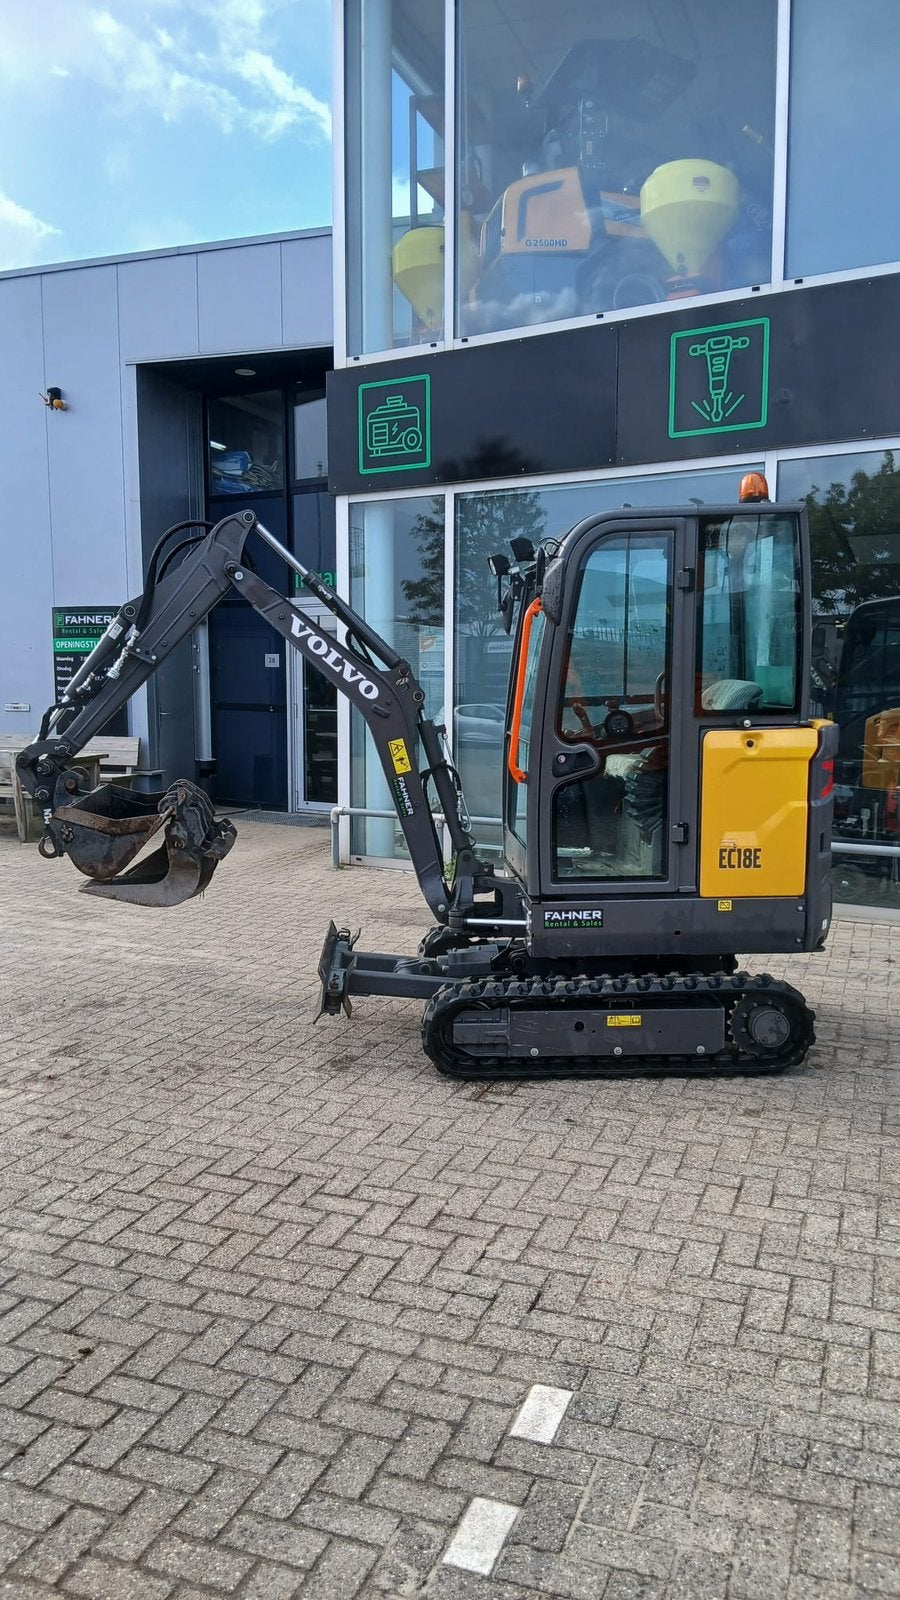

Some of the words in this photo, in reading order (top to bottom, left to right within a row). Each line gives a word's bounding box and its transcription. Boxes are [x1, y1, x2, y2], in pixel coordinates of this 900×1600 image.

[525, 239, 568, 247] G2500HD
[65, 616, 111, 624] FAHNER
[291, 613, 379, 700] VOLVO
[398, 777, 413, 815] FAHNER
[718, 848, 762, 869] EC18E
[544, 910, 602, 920] FAHNER
[544, 920, 571, 928] Rental
